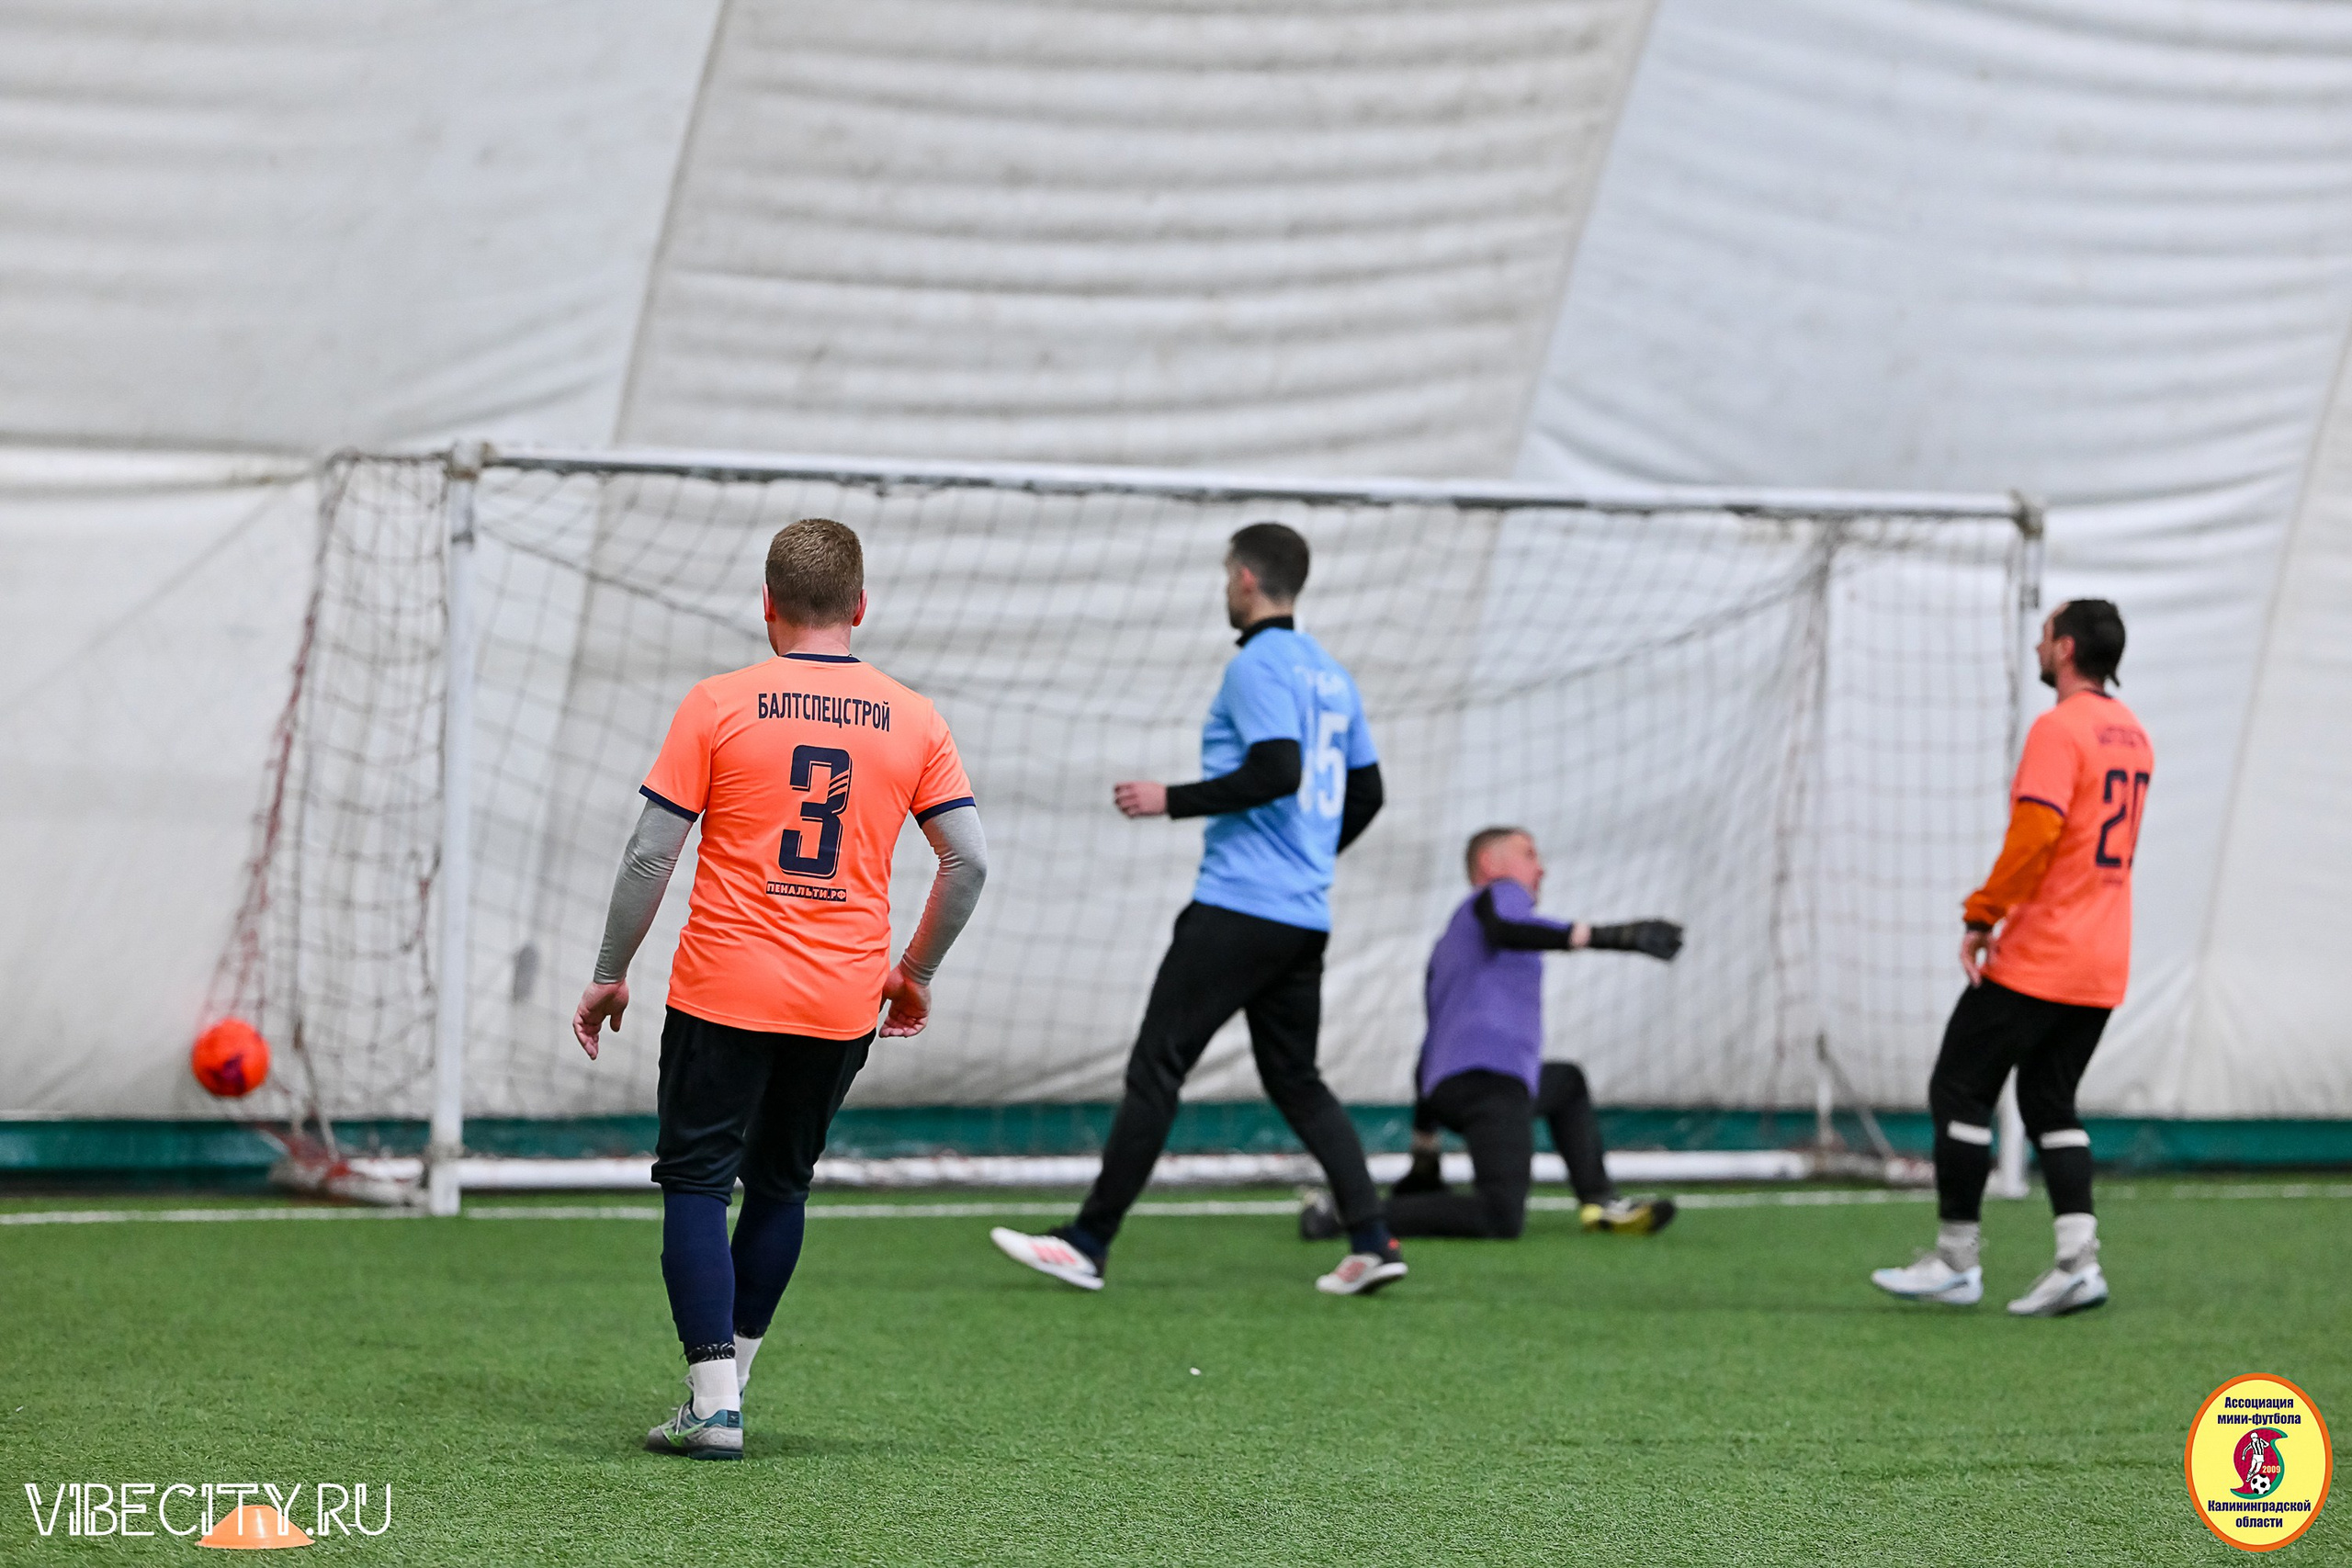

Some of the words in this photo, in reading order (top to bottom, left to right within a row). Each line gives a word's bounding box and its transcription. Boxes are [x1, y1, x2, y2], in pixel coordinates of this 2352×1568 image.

[758, 693, 890, 732] БАЛТСПЕЦСТРОЙ
[778, 745, 853, 880] 3
[766, 881, 847, 902] ПЕНАЛЬТИ.РФ
